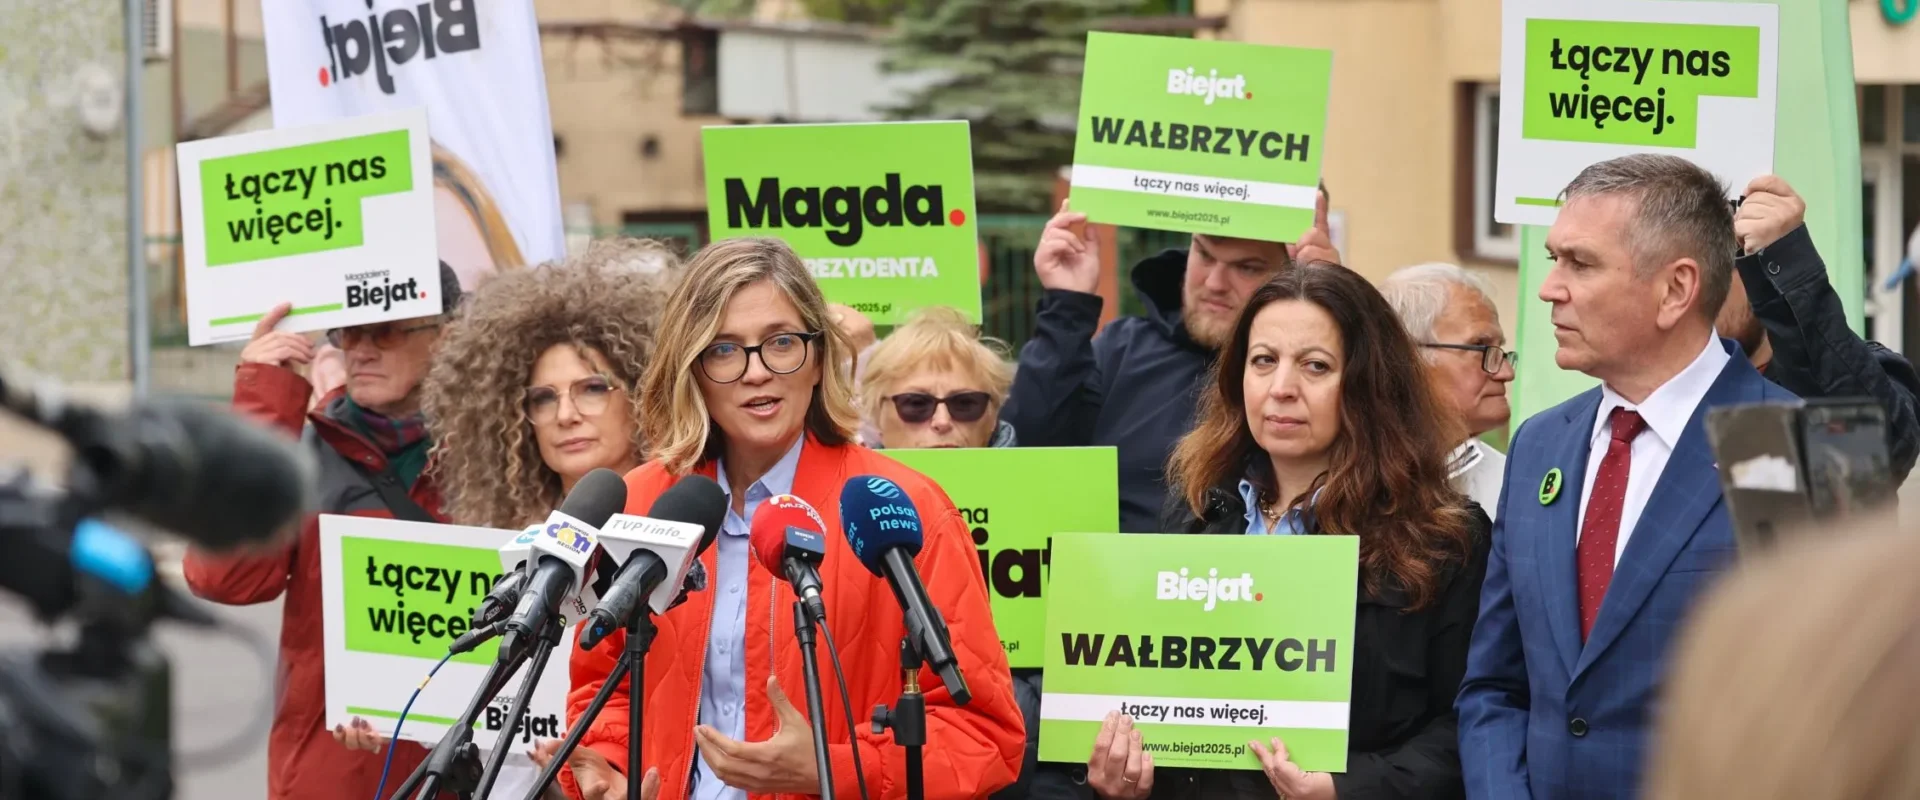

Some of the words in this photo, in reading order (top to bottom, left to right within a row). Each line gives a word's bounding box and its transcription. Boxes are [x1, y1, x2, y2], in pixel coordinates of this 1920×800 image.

[1551, 38, 1654, 86] Łączy
[1662, 48, 1730, 78] nas
[1167, 66, 1253, 105] Biejat.
[1550, 84, 1675, 135] więcej.
[1091, 116, 1310, 162] WAŁBRZYCH
[225, 166, 316, 204] Łączy
[325, 155, 387, 186] nas
[1134, 175, 1171, 193] Łączy
[1175, 180, 1199, 192] nas
[1204, 182, 1250, 200] więcej.
[227, 198, 342, 243] więcej.
[725, 173, 966, 247] Magda.
[1147, 208, 1230, 226] www.biejat2025.pl
[802, 257, 938, 278] REZYDENTA
[347, 277, 426, 312] Biejat.
[870, 503, 916, 520] polsat
[880, 517, 918, 532] news
[367, 555, 462, 605] Łączy
[1156, 566, 1263, 611] Biejat.
[1061, 633, 1335, 672] WAŁBRZYCH
[1121, 701, 1169, 722] Łączy
[1174, 704, 1205, 719] nas
[1210, 703, 1268, 726] więcej.
[1142, 741, 1245, 758] www.biejat2025.pl
